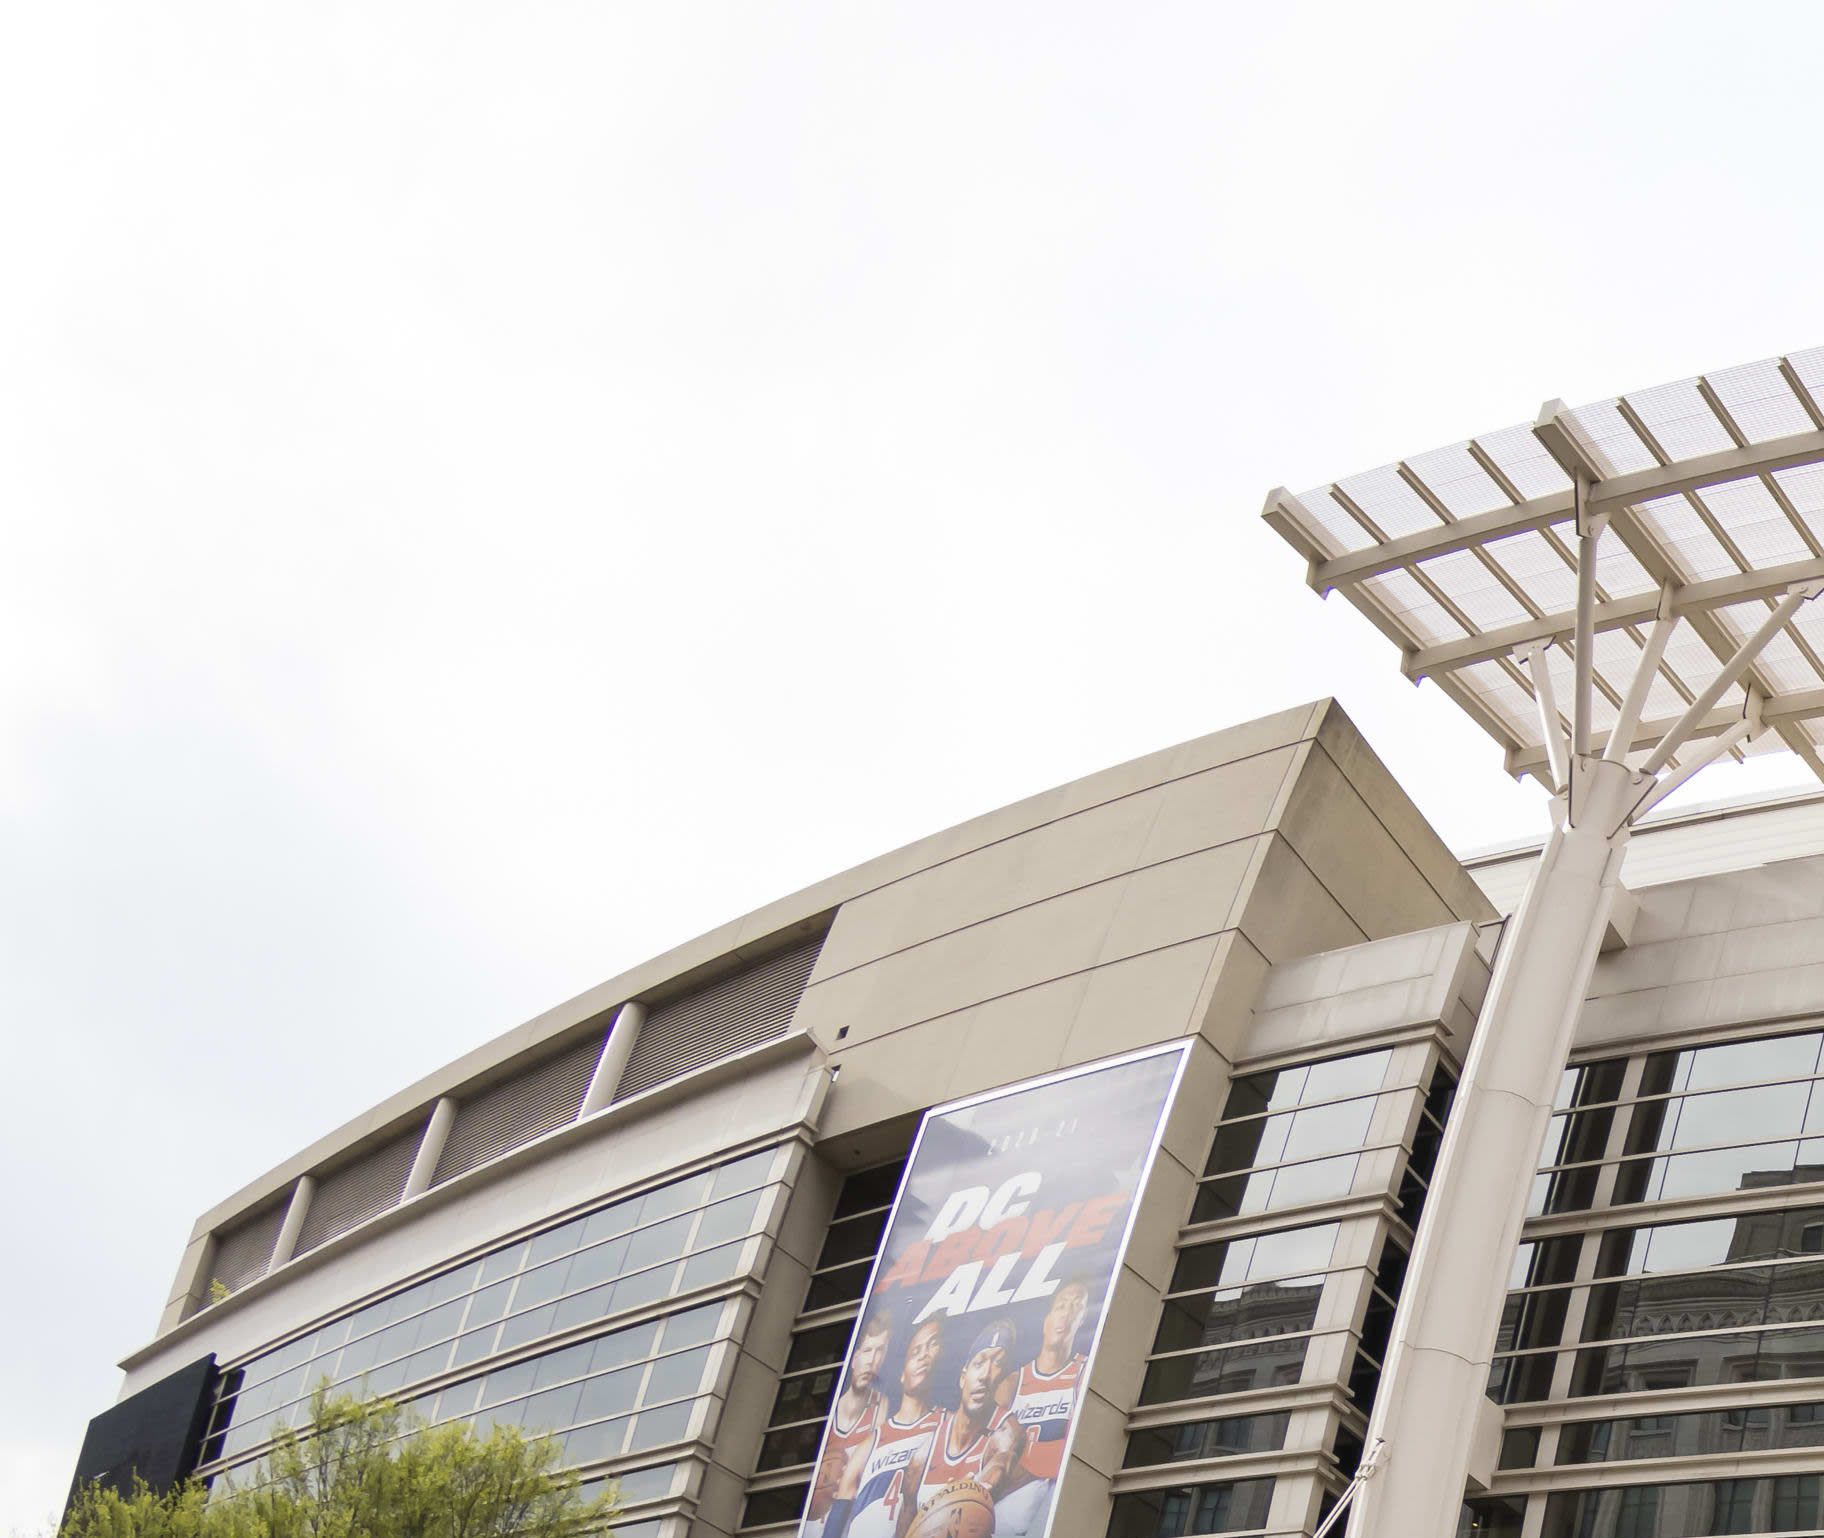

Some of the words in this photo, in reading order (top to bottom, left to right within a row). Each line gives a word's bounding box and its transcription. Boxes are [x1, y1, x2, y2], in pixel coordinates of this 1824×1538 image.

[872, 1191, 1130, 1296] ABOVE
[922, 1171, 1043, 1245] DC
[911, 1240, 1068, 1325] ALL
